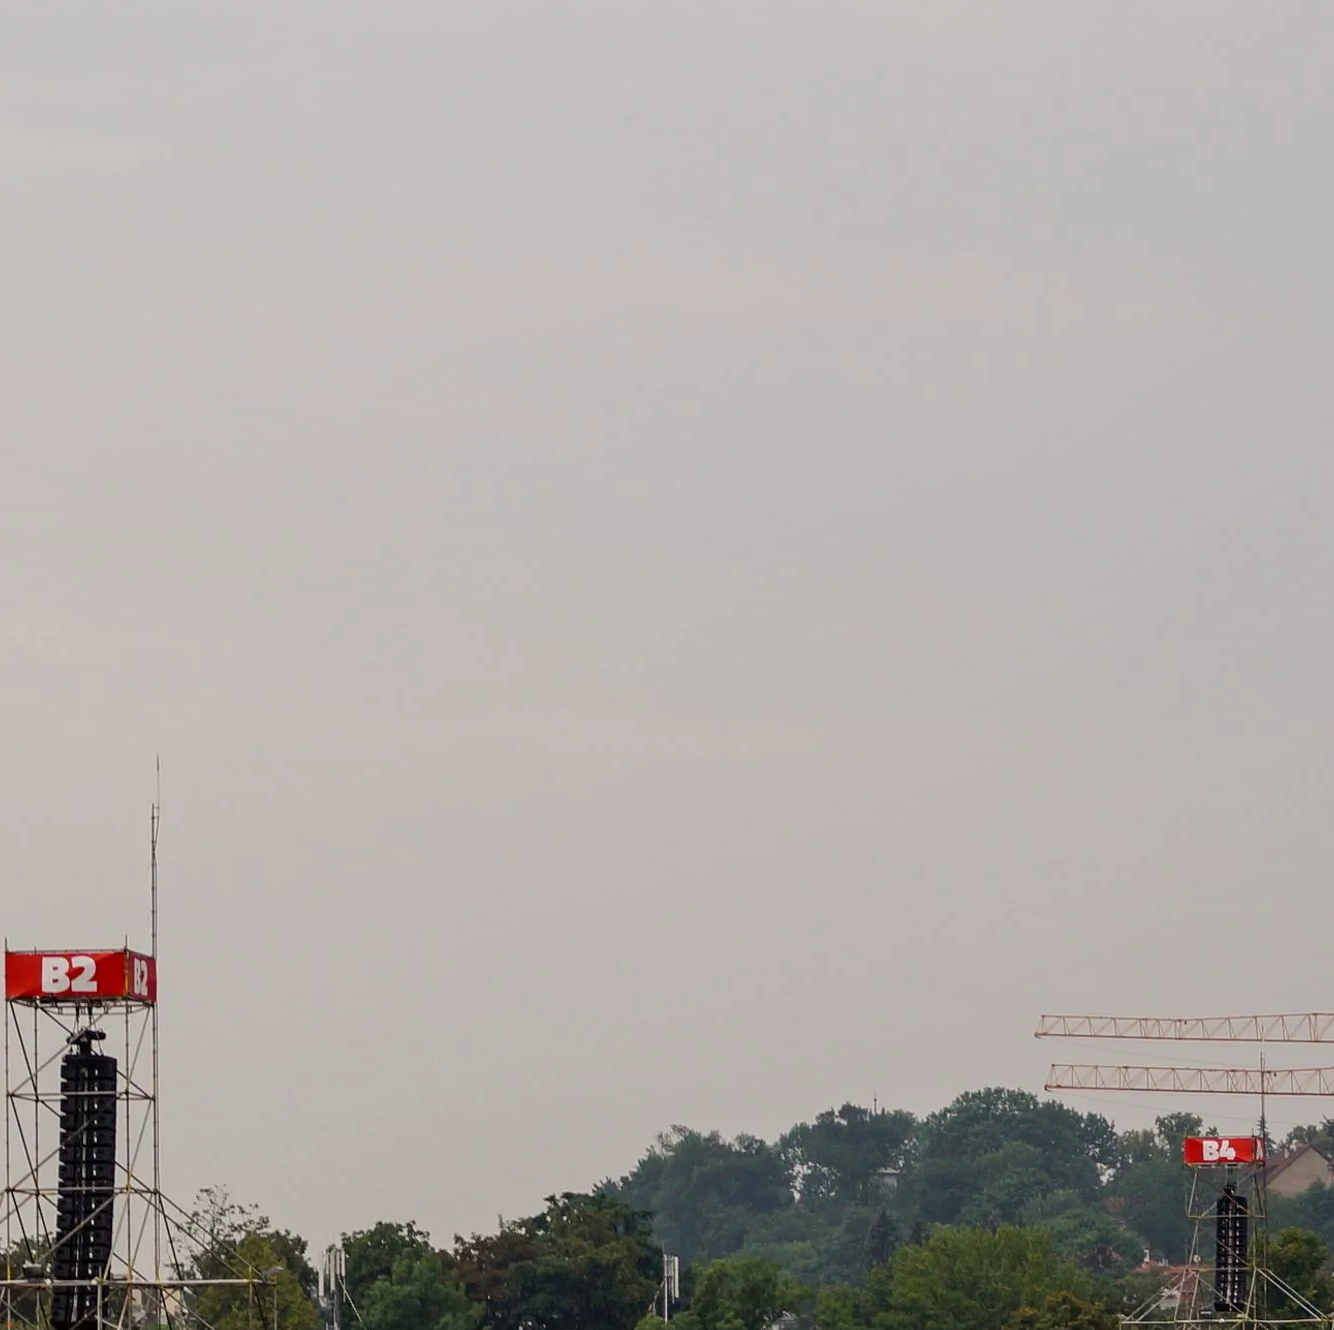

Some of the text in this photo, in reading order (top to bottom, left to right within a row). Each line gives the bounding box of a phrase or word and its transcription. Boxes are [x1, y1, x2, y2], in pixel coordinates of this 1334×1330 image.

[41, 955, 97, 993] B2
[133, 957, 148, 997] B2
[1202, 1140, 1236, 1161] B4
